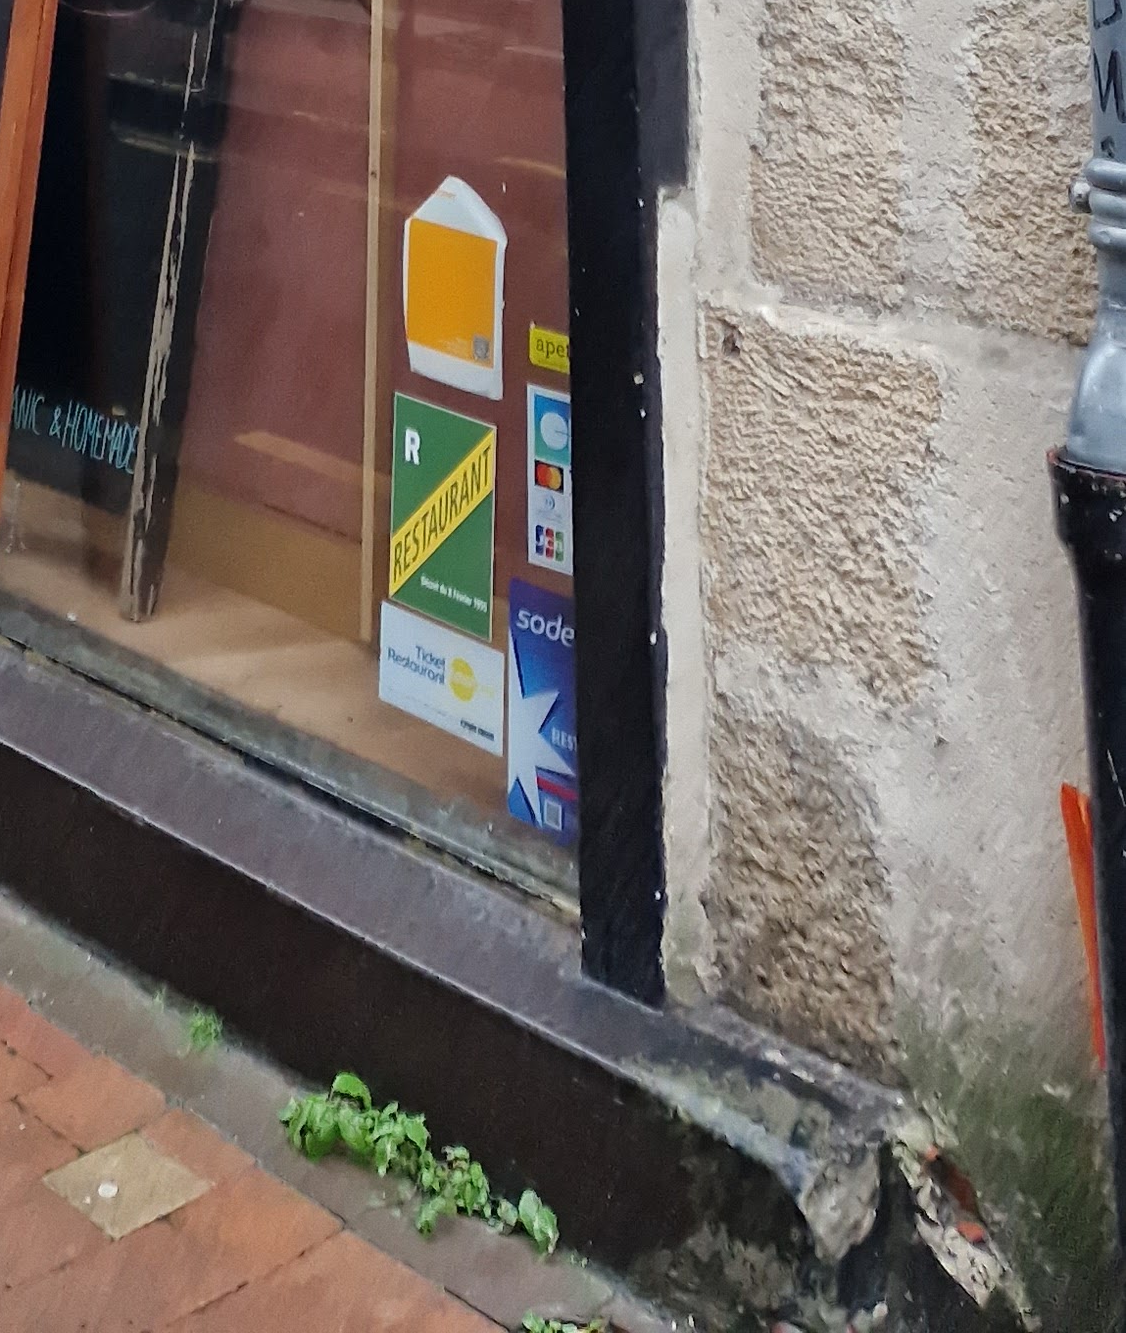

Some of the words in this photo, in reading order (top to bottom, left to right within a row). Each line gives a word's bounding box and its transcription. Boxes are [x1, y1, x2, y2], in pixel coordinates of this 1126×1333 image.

[61, 398, 140, 475] HOMEMADE
[405, 428, 421, 466] R
[394, 446, 491, 584] RESTAURANT
[387, 646, 445, 686] Restaurant
[415, 645, 445, 672] Ticket
